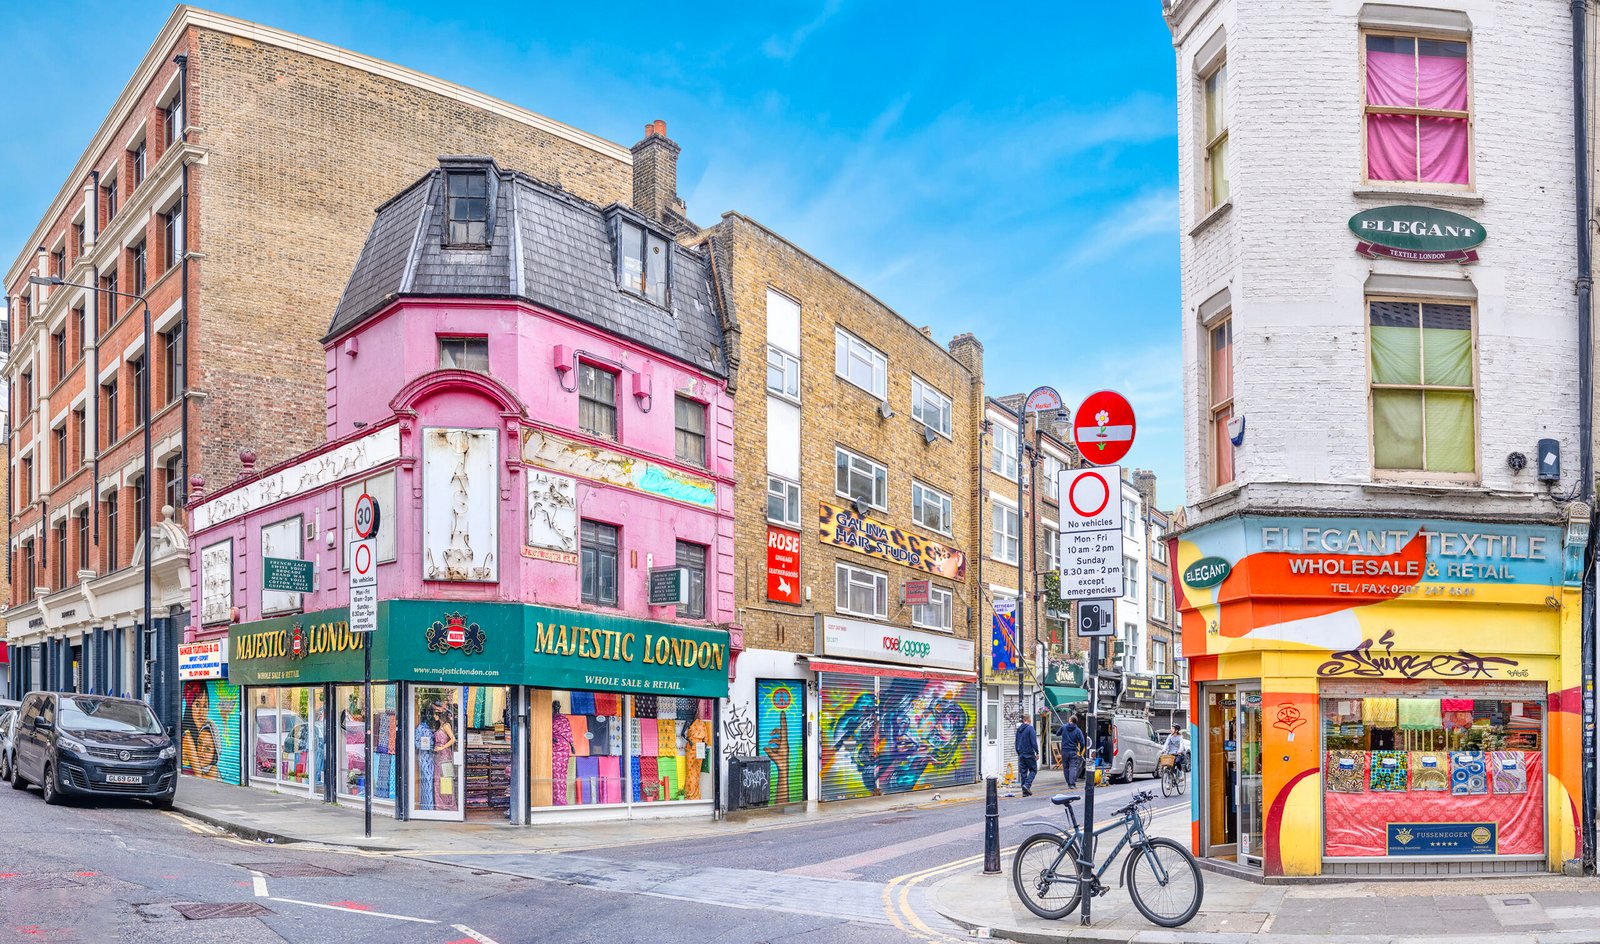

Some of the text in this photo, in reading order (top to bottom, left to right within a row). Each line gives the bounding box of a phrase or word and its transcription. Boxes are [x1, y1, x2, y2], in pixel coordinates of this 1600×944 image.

[1361, 220, 1475, 237] ELEGANT
[1390, 249, 1445, 260] TEXTILE LONDON
[357, 507, 371, 526] 30
[1068, 518, 1113, 528] No vehicles
[835, 513, 889, 540] GALINA
[768, 531, 800, 553] ROSE
[835, 528, 921, 565] HAIR STUDIO
[1074, 535, 1090, 543] Mon
[1261, 527, 1546, 560] ELEGANT TEXTILE
[775, 554, 793, 563] LUGGAGE
[1076, 557, 1106, 565] Sunday
[1186, 563, 1226, 581] ELEGANT
[1288, 558, 1516, 579] WHOLESALE & RETAIL
[1078, 577, 1105, 586] except
[1067, 586, 1116, 596] emergencies
[1391, 585, 1420, 594] 0207
[1424, 586, 1445, 595] 247
[236, 621, 364, 660] MAJESTIC LONDO
[534, 621, 726, 671] MAJESTIC LONDON
[413, 667, 500, 676] www.majesticlondon.com
[585, 675, 619, 687] WHOLE
[620, 678, 642, 688] SALE
[643, 679, 651, 688] &
